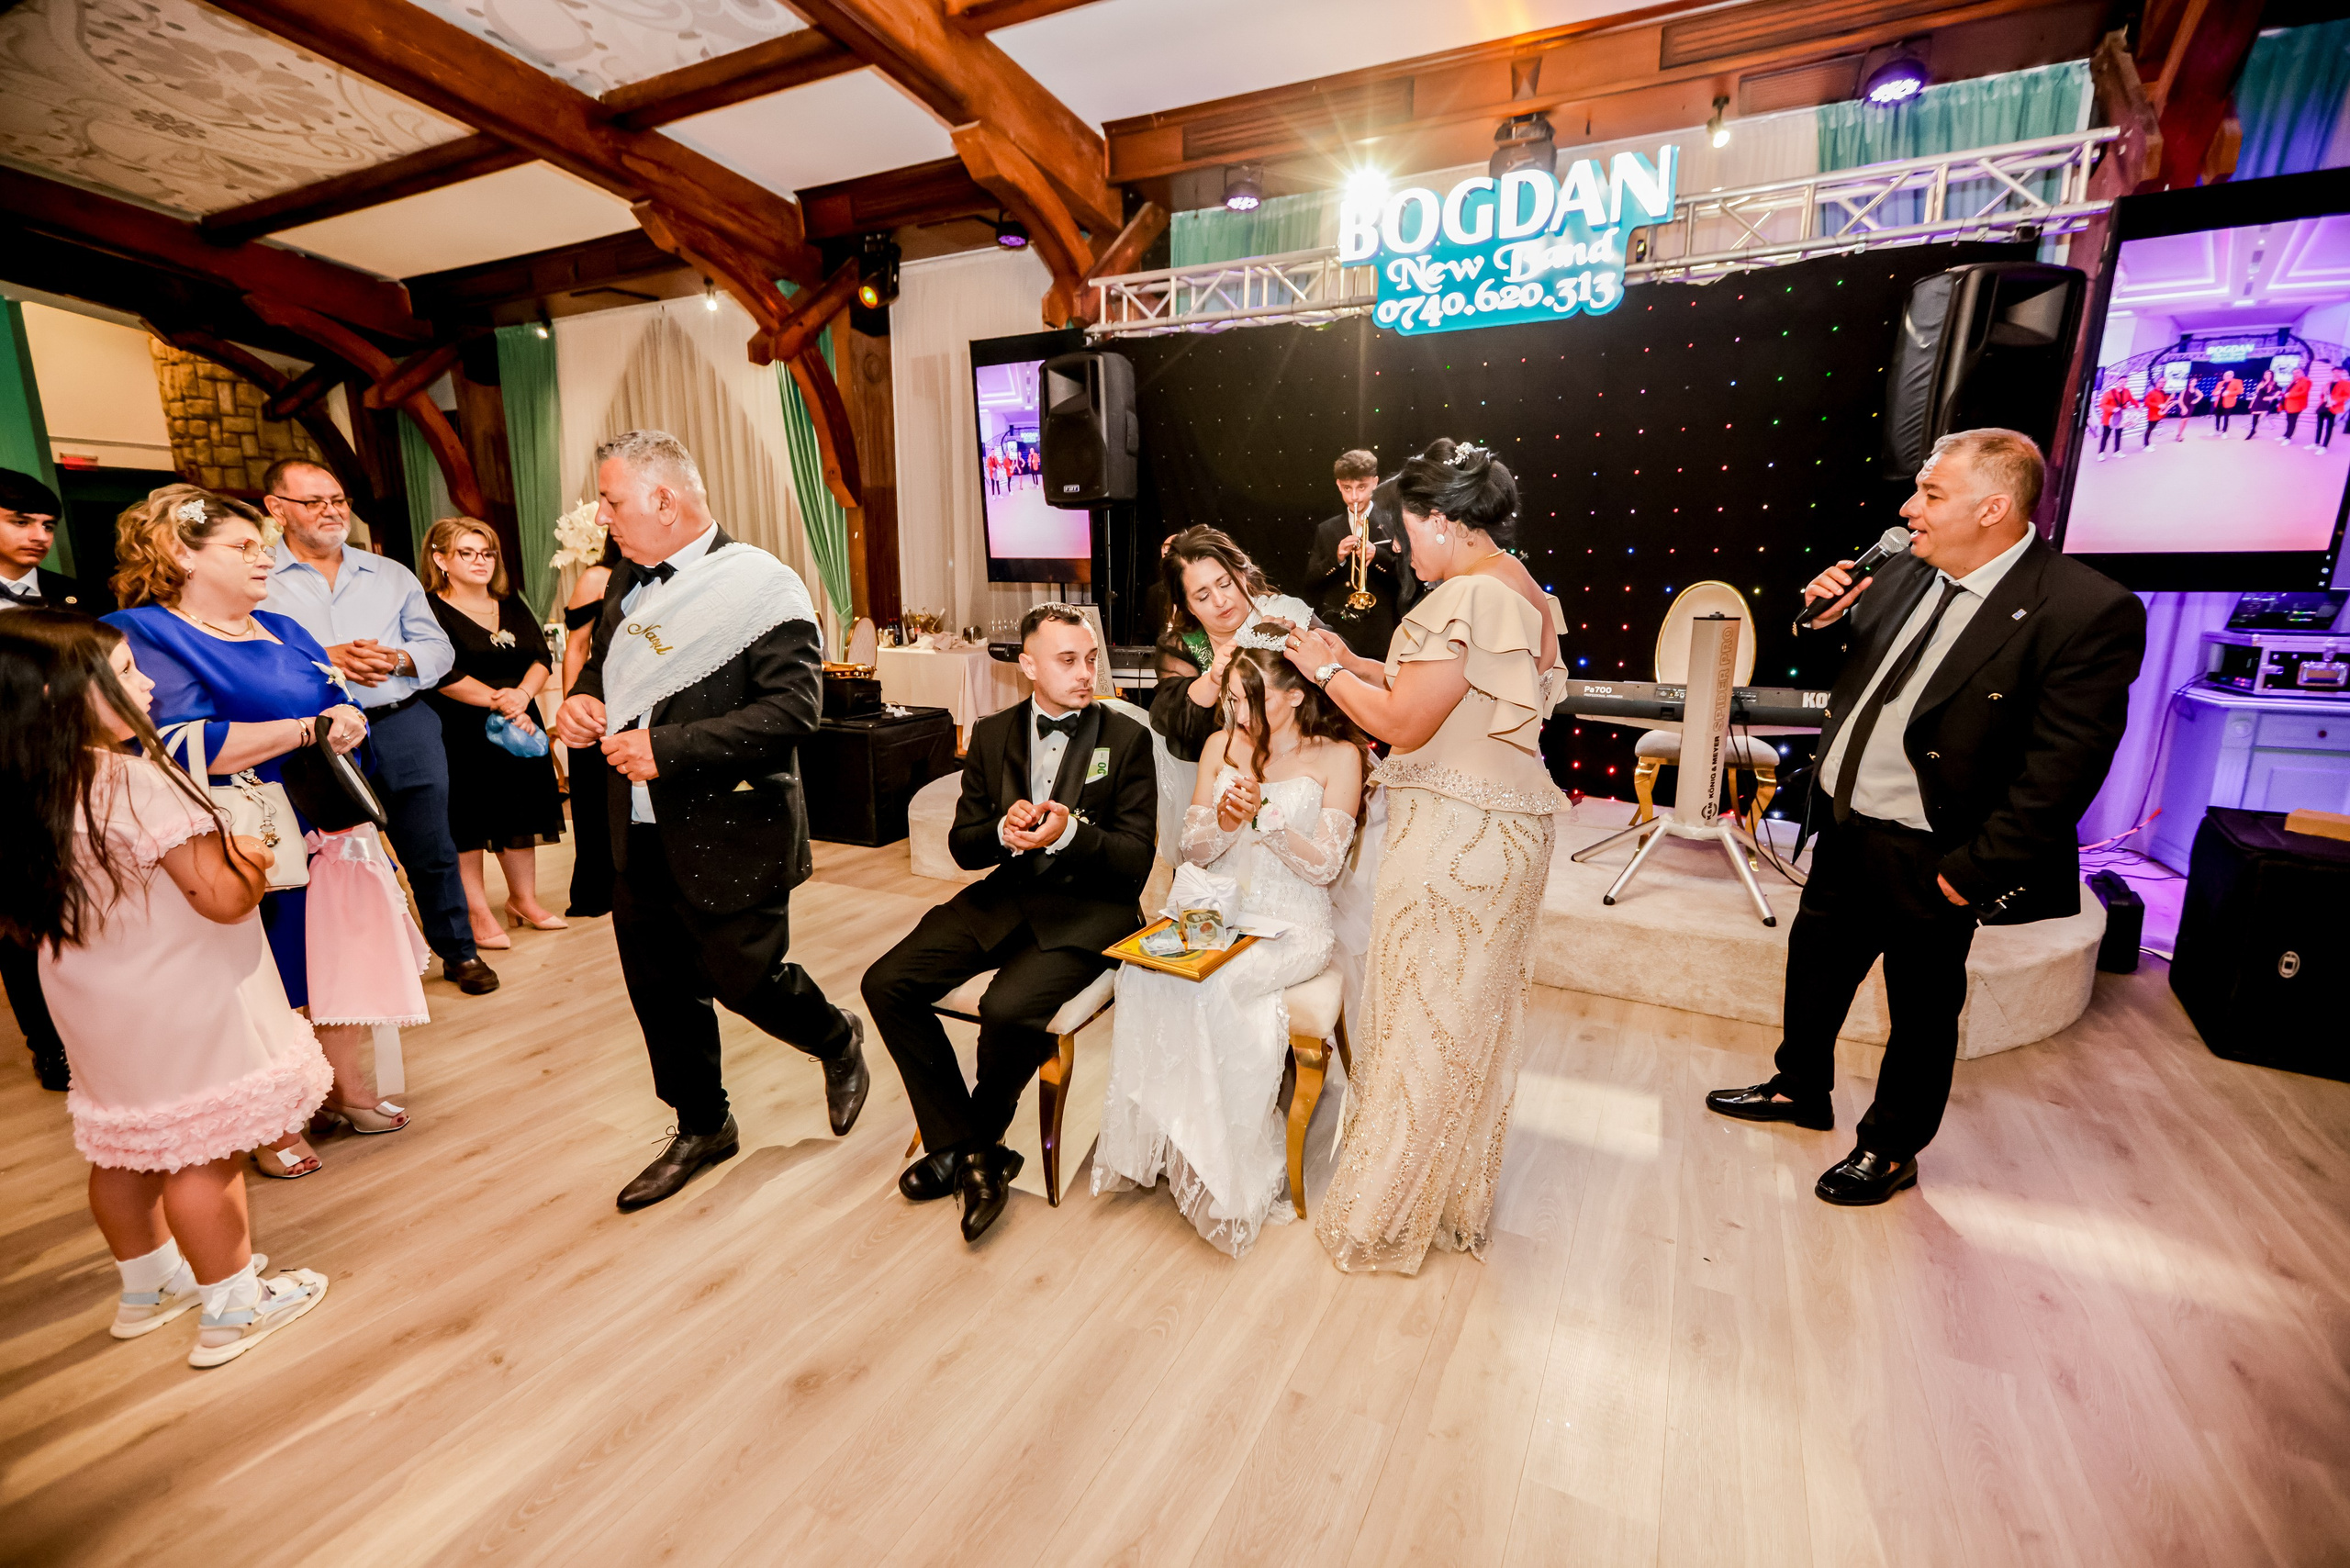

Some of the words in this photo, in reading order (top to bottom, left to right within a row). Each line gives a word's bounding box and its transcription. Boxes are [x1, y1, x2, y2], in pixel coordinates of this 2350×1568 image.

[1339, 144, 1674, 263] BOGDAN
[1386, 254, 1484, 294] New
[1494, 227, 1620, 284] Band
[1377, 270, 1616, 330] 0740.620.313
[1719, 627, 1734, 666] PRO
[1583, 686, 1612, 694] Pa700
[1713, 668, 1729, 732] SPIDER
[1802, 692, 1831, 708] KO
[1712, 735, 1720, 766] MEYER
